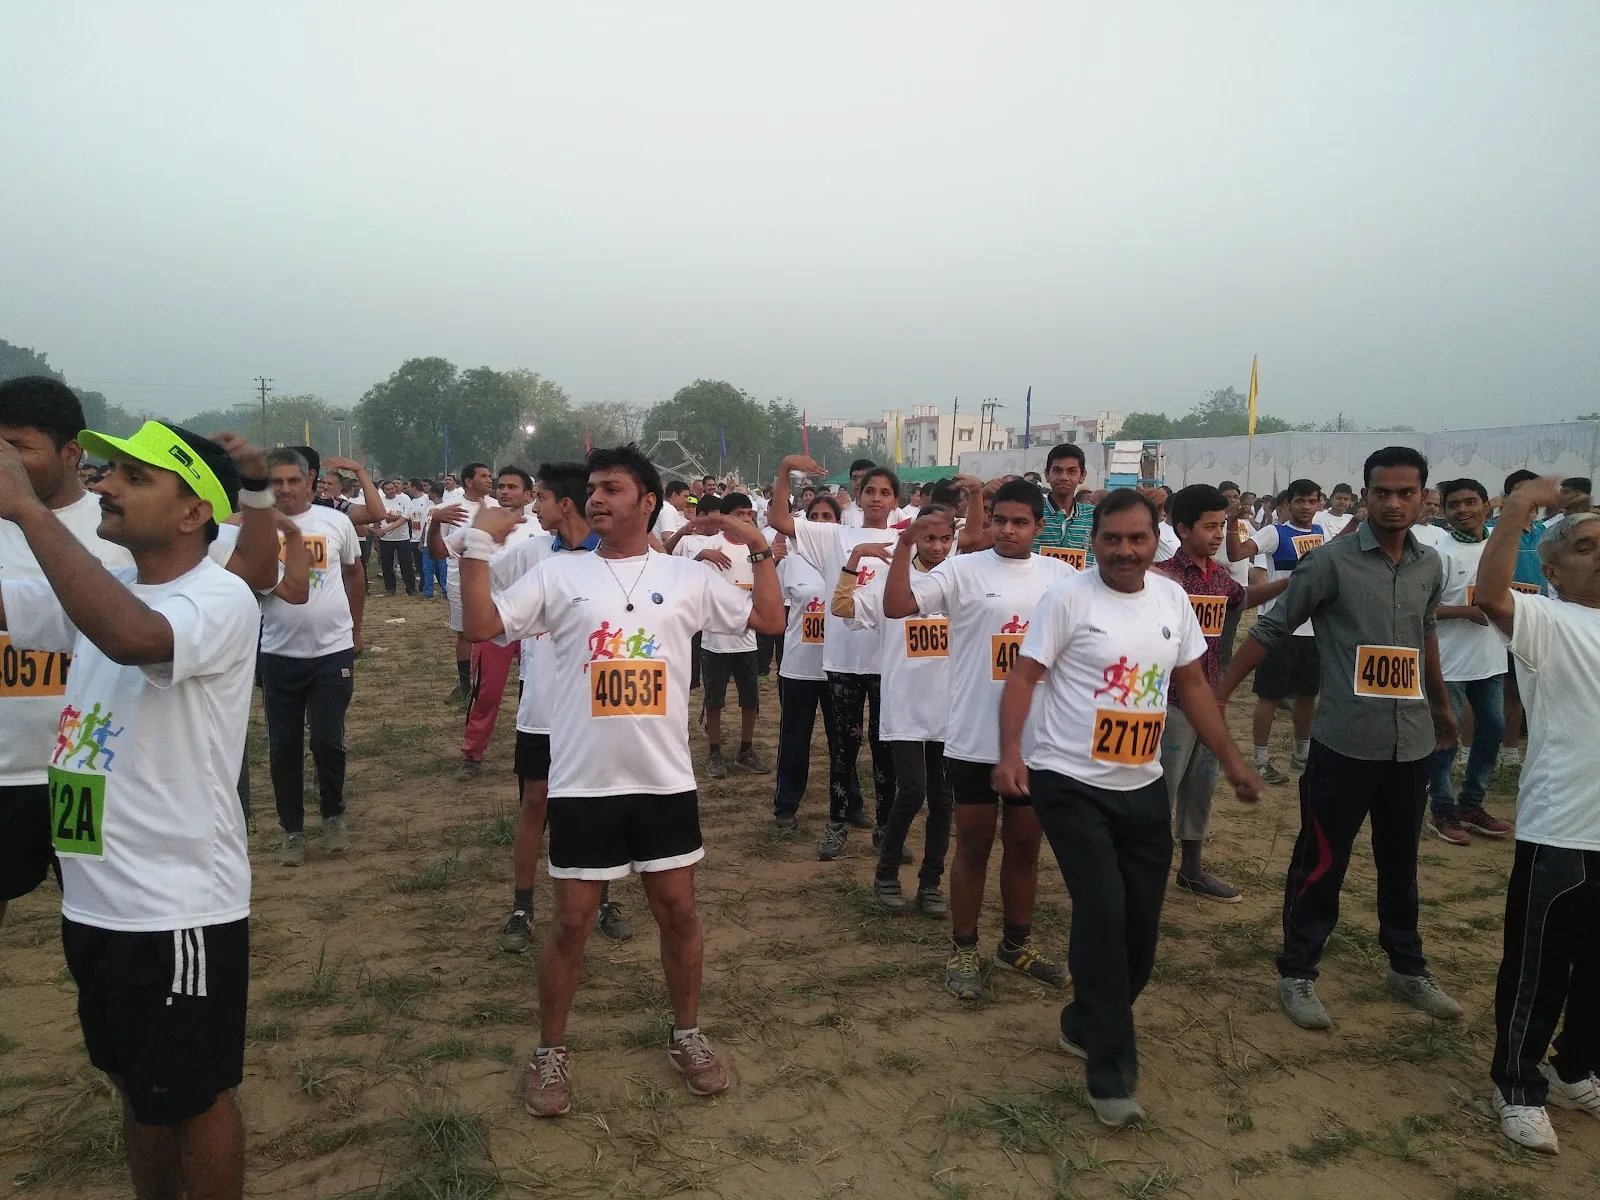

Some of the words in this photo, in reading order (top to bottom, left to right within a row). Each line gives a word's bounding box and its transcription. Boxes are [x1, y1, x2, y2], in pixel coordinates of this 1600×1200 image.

[1191, 602, 1224, 629] 061F
[909, 624, 948, 652] 5065
[595, 669, 662, 707] 4053F
[1362, 655, 1415, 689] 4080F
[1097, 718, 1161, 756] 2717D
